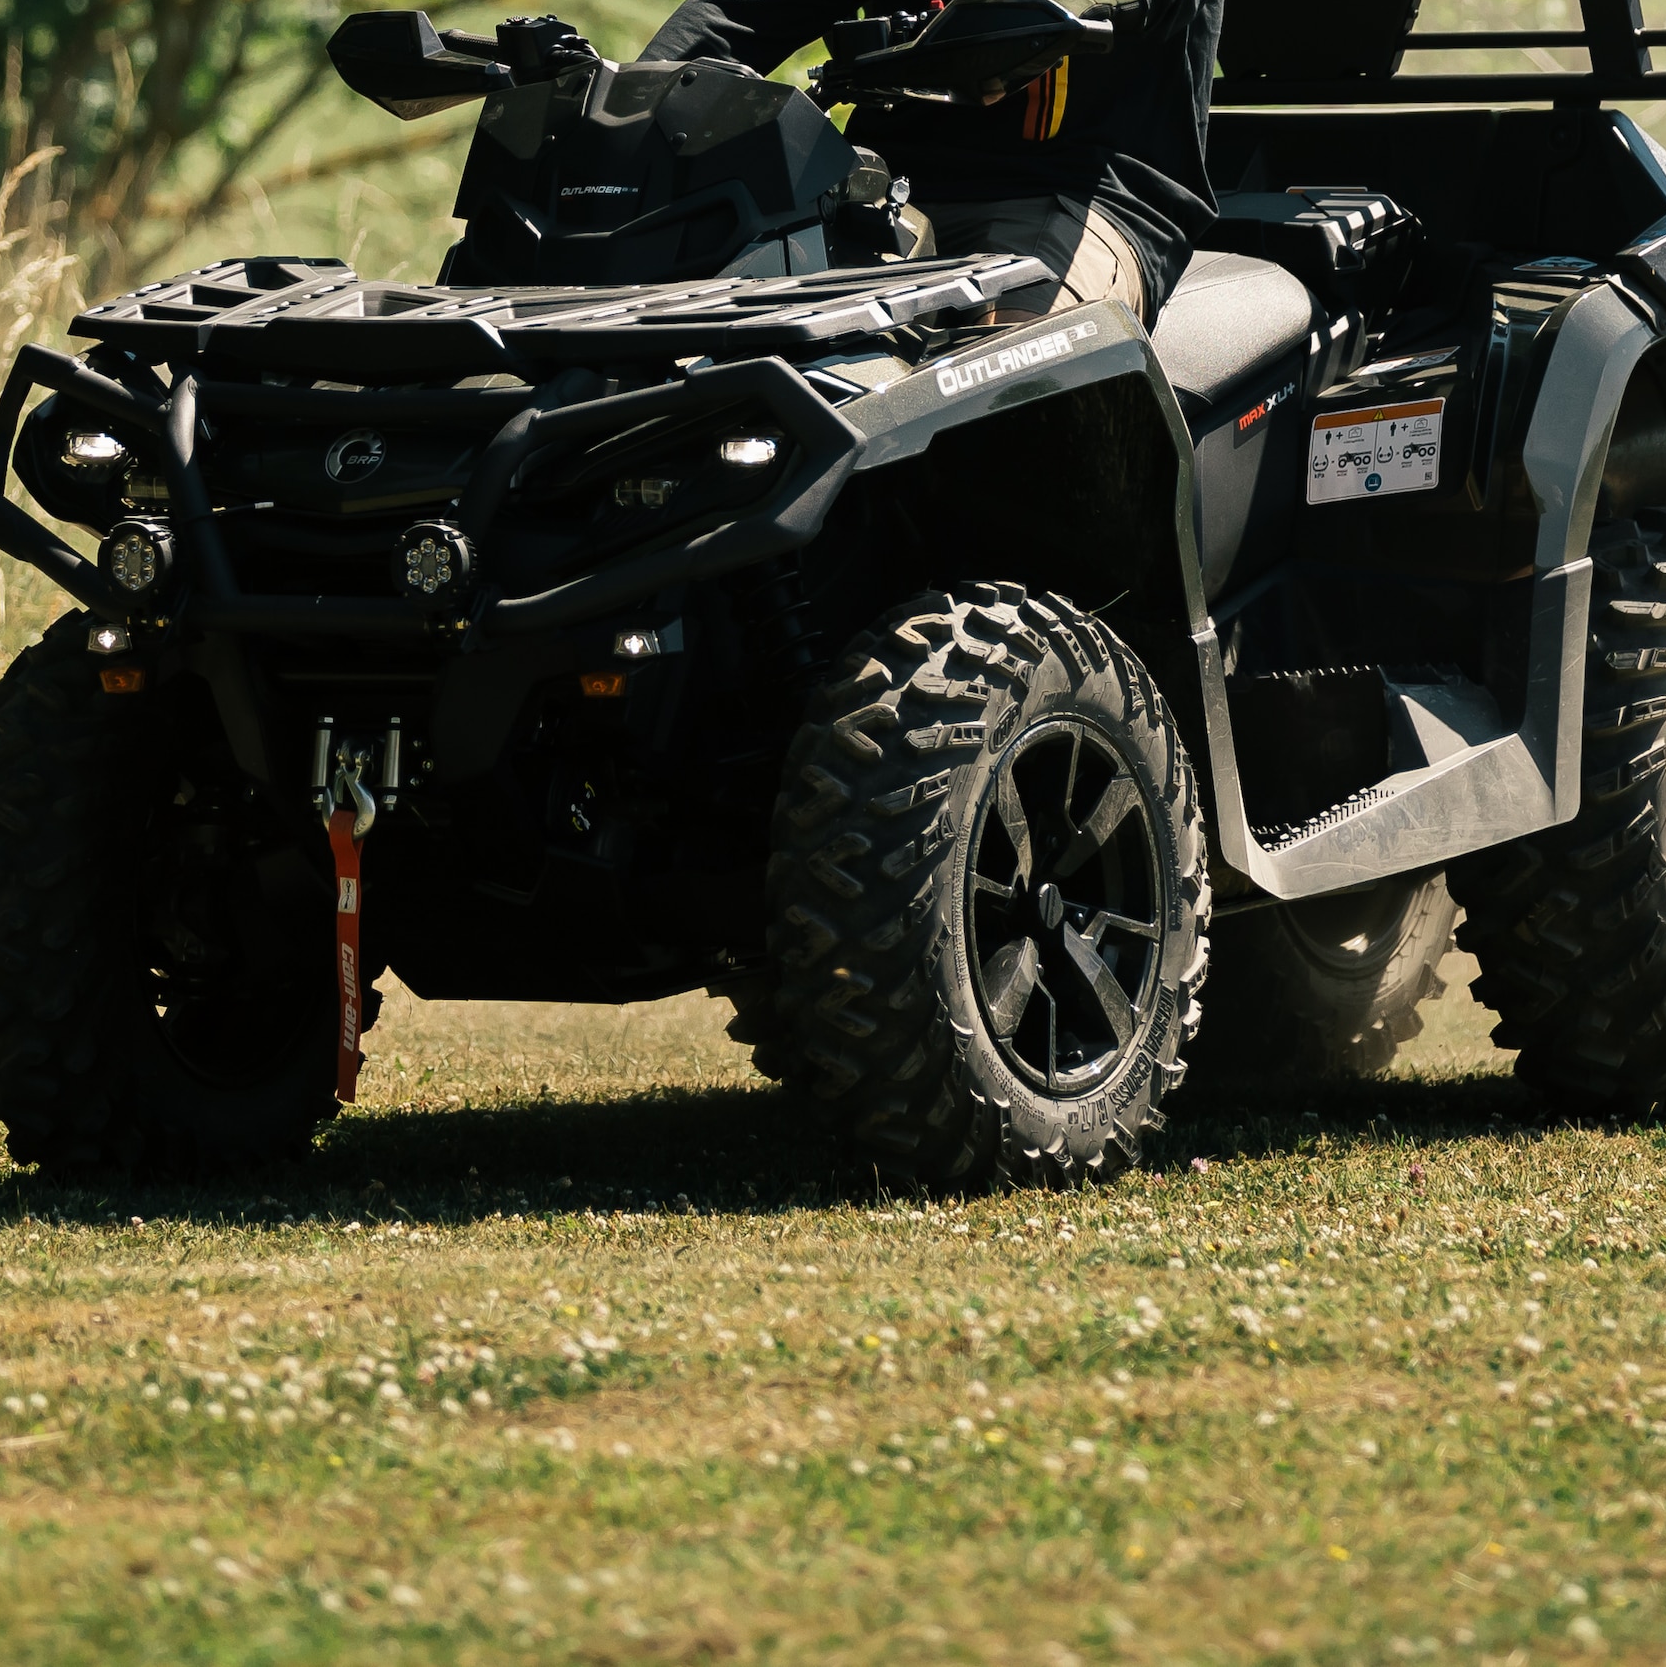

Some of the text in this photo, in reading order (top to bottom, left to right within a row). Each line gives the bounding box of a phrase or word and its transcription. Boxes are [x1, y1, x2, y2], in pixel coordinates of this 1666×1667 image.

[560, 186, 622, 196] OUTLANDER
[936, 332, 1074, 397] OUTLANDER
[1238, 382, 1295, 431] MAX XU+
[346, 455, 380, 465] BRP
[342, 942, 357, 1052] can-am
[1108, 1051, 1153, 1117] CROSS
